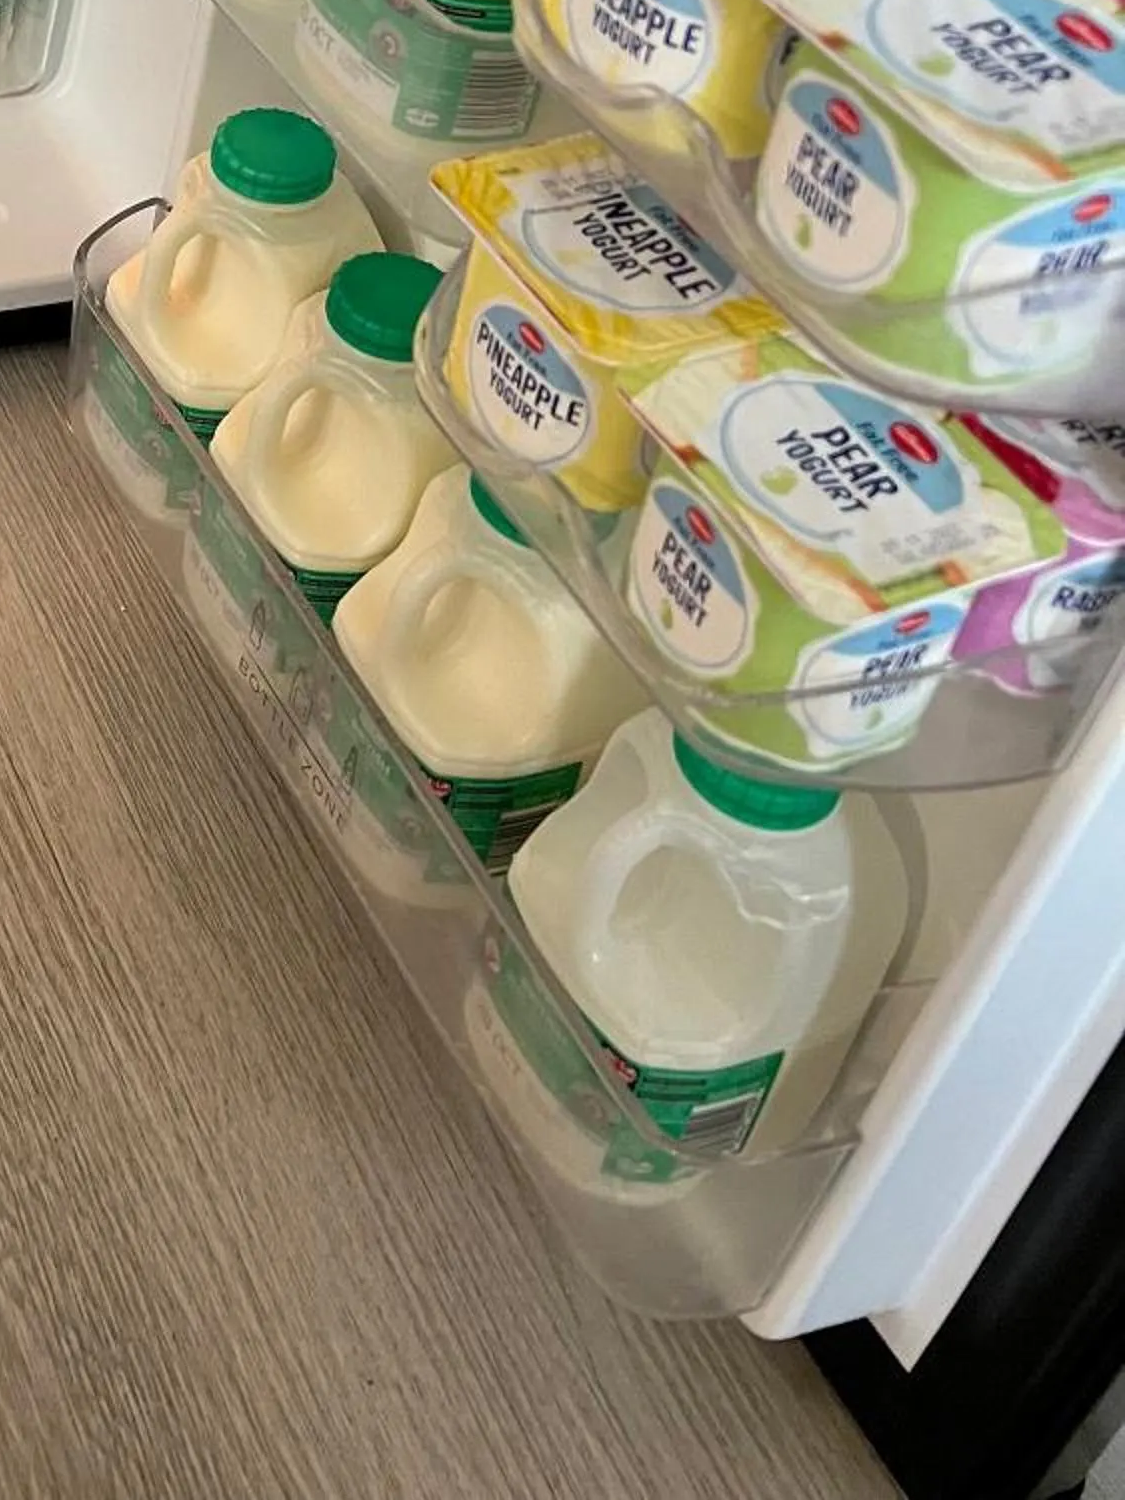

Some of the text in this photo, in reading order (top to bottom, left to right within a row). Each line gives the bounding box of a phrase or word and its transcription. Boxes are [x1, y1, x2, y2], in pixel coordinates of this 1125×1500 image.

[592, 3, 658, 65] YOGURT
[930, 23, 1040, 95] YOGURT
[968, 18, 1071, 84] PEAR
[785, 163, 853, 238] YOGURT
[797, 132, 861, 206] PEAR
[573, 180, 718, 301] PINEAPPLE
[573, 212, 652, 282] YOGURT
[476, 323, 584, 427] PINEAPPLE
[489, 368, 546, 431] YOGURT
[775, 429, 871, 514] YOGURT
[811, 425, 898, 500] PEAR
[652, 550, 708, 628] YOGURT
[660, 531, 712, 604] PEAR
